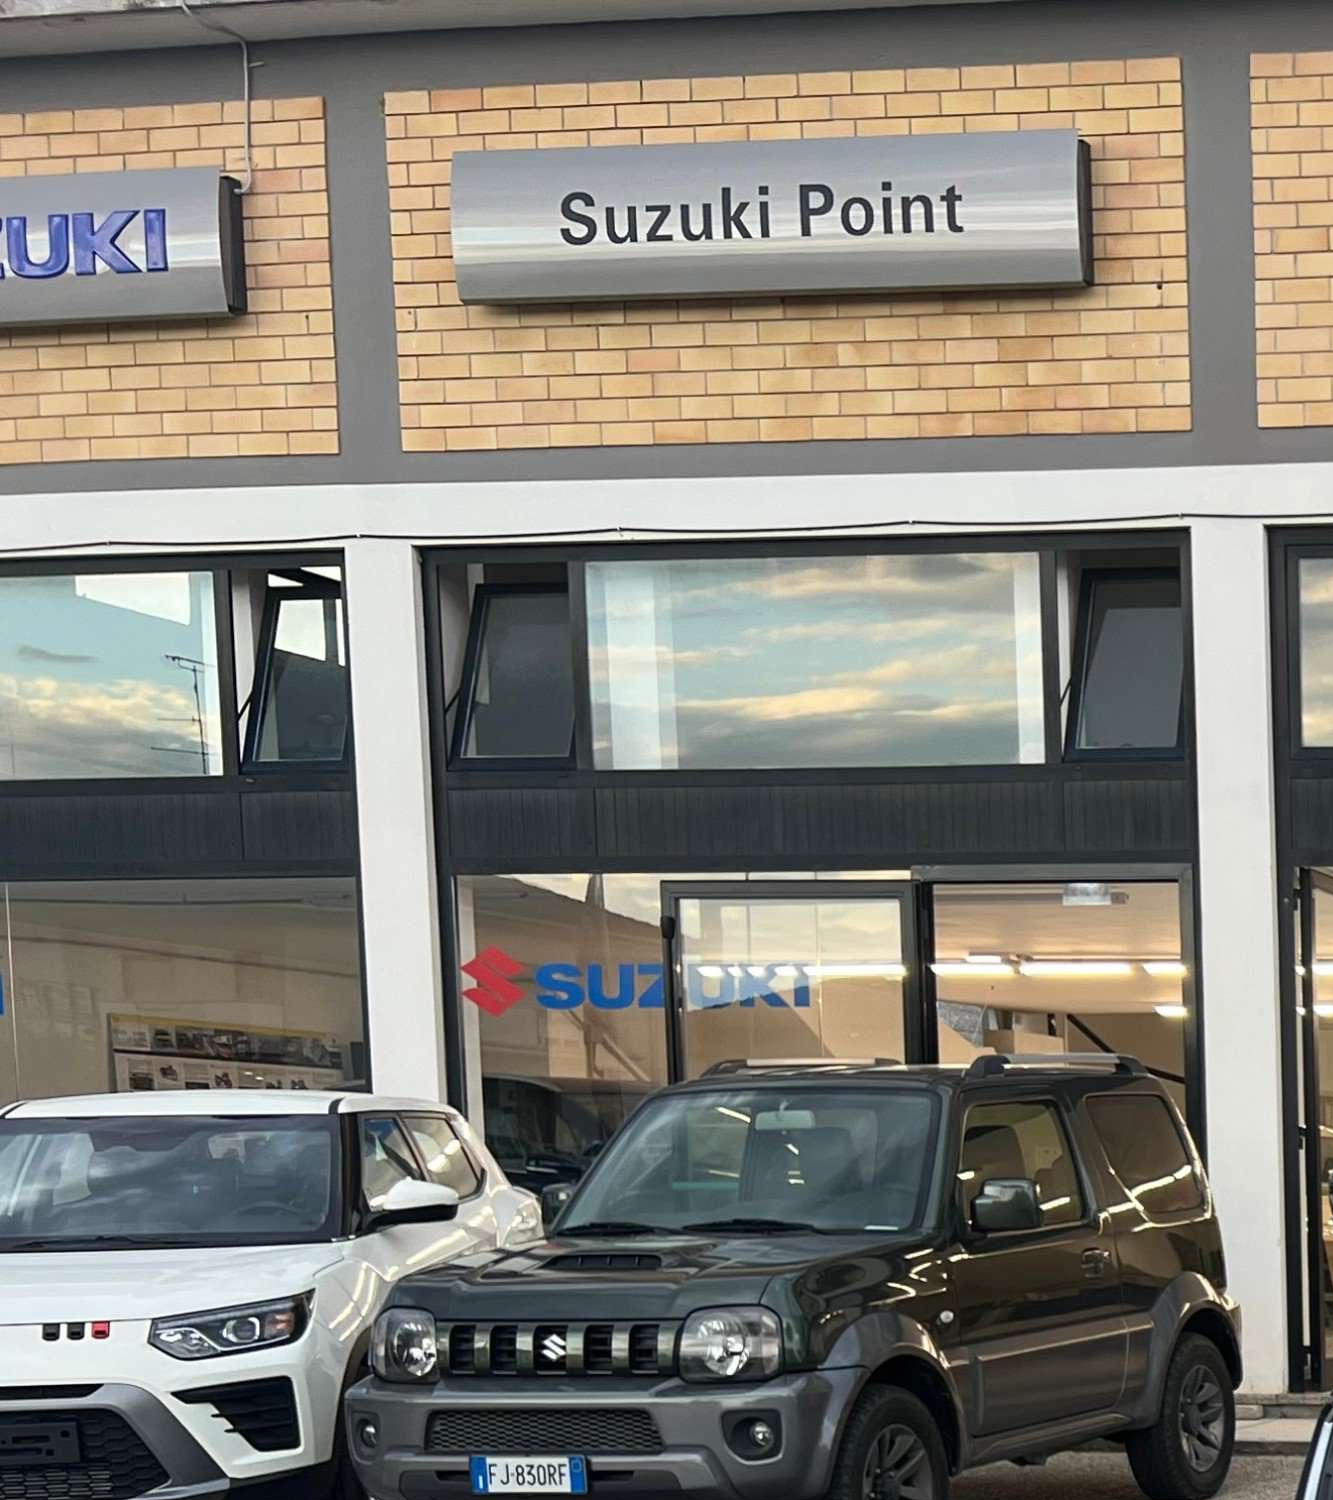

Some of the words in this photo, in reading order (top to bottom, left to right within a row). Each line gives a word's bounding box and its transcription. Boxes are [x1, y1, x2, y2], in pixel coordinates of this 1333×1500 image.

[0, 208, 169, 280] UKI
[560, 185, 770, 246] Suzuki
[799, 181, 964, 237] Point
[534, 963, 811, 1009] SUZUKI
